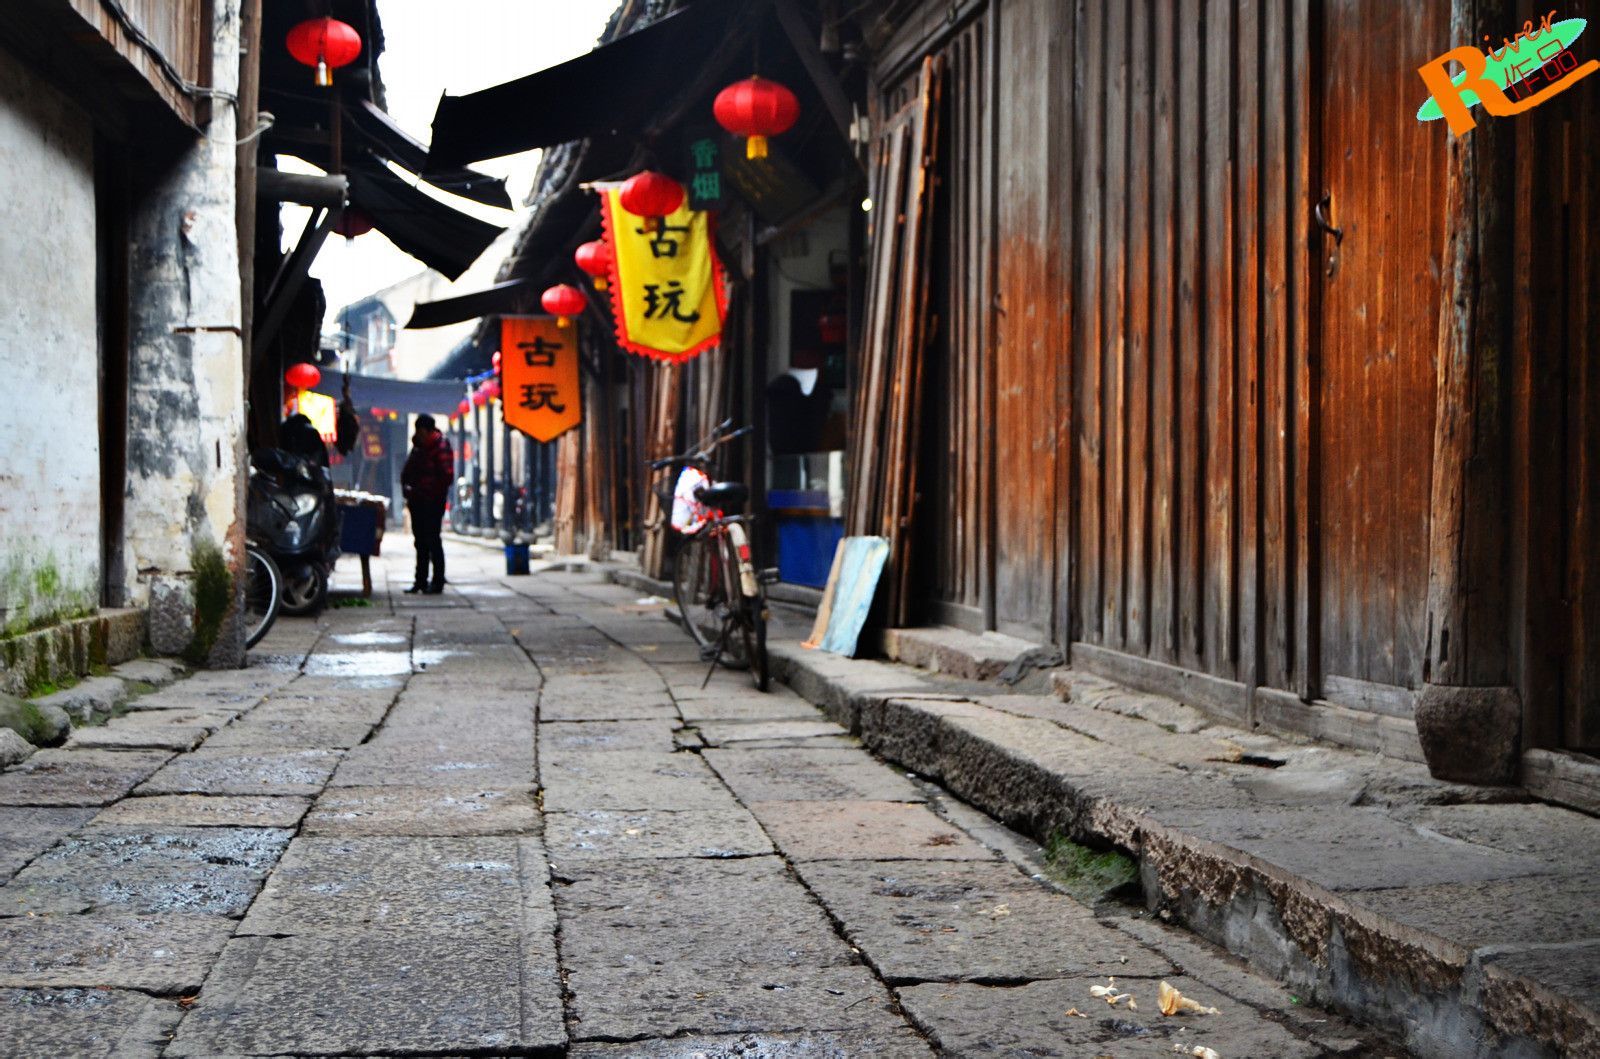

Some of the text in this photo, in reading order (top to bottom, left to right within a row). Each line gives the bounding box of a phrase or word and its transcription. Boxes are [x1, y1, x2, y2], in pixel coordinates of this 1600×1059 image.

[691, 138, 721, 200] 香烟
[635, 215, 700, 323] 古玩
[517, 336, 566, 413] 古玩
